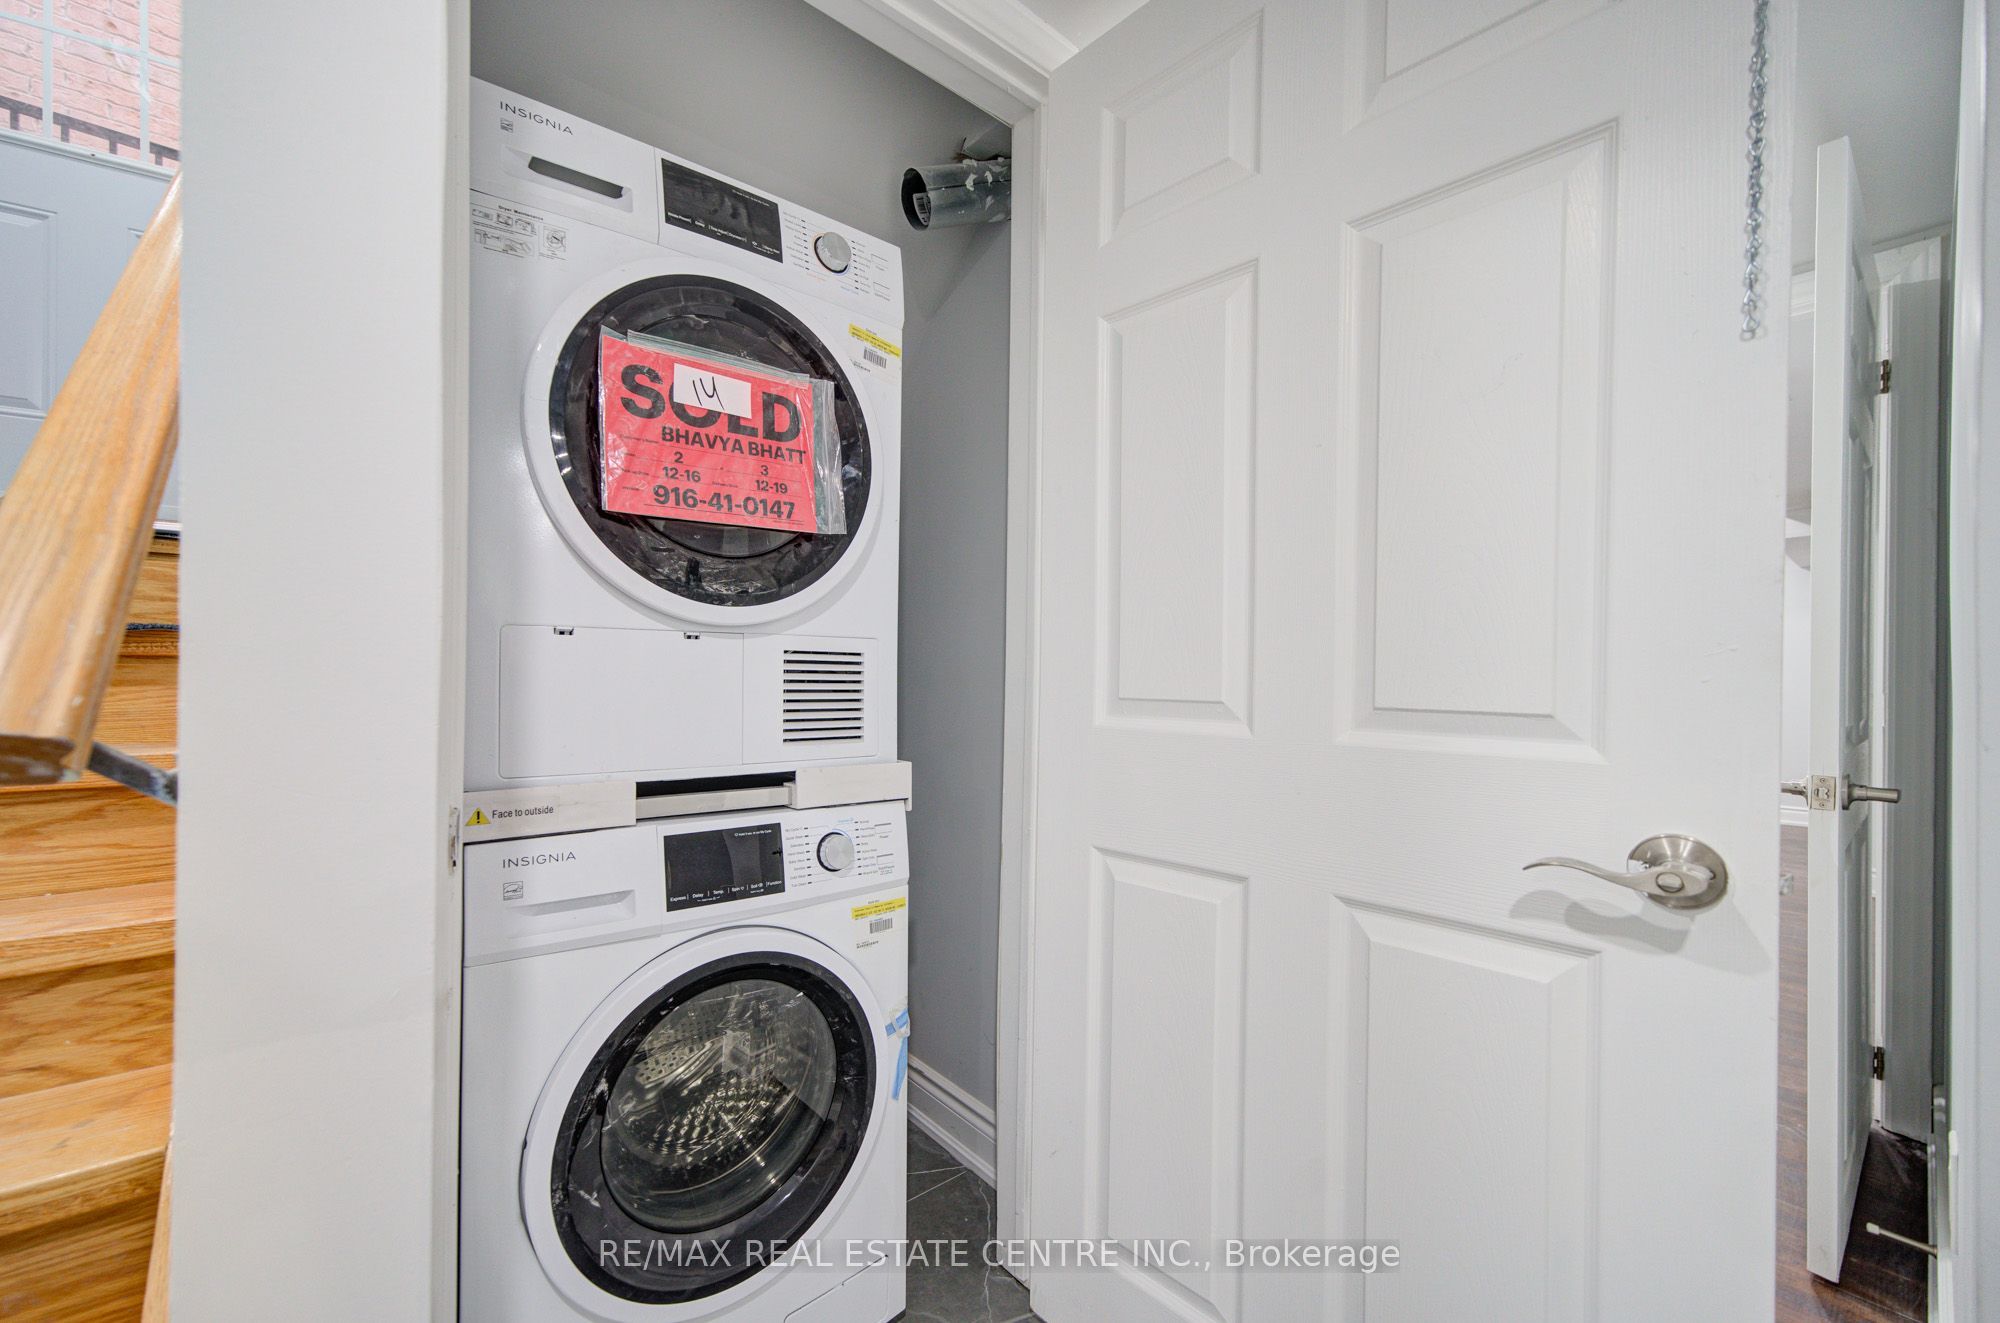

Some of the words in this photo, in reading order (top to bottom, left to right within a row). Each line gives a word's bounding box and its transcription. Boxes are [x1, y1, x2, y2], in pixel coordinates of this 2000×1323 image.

[500, 101, 574, 135] INSIGNIA
[661, 425, 745, 455] BHAVYA
[748, 441, 806, 464] BHATT
[673, 451, 684, 464] 2
[662, 466, 702, 483] 12-16
[760, 465, 769, 476] 3
[755, 479, 788, 494] 12-19
[653, 484, 795, 519] 916-41-0147
[492, 809, 513, 819] Face
[514, 808, 523, 817] to
[524, 806, 554, 816] outside
[502, 851, 577, 869] INSIGNIA
